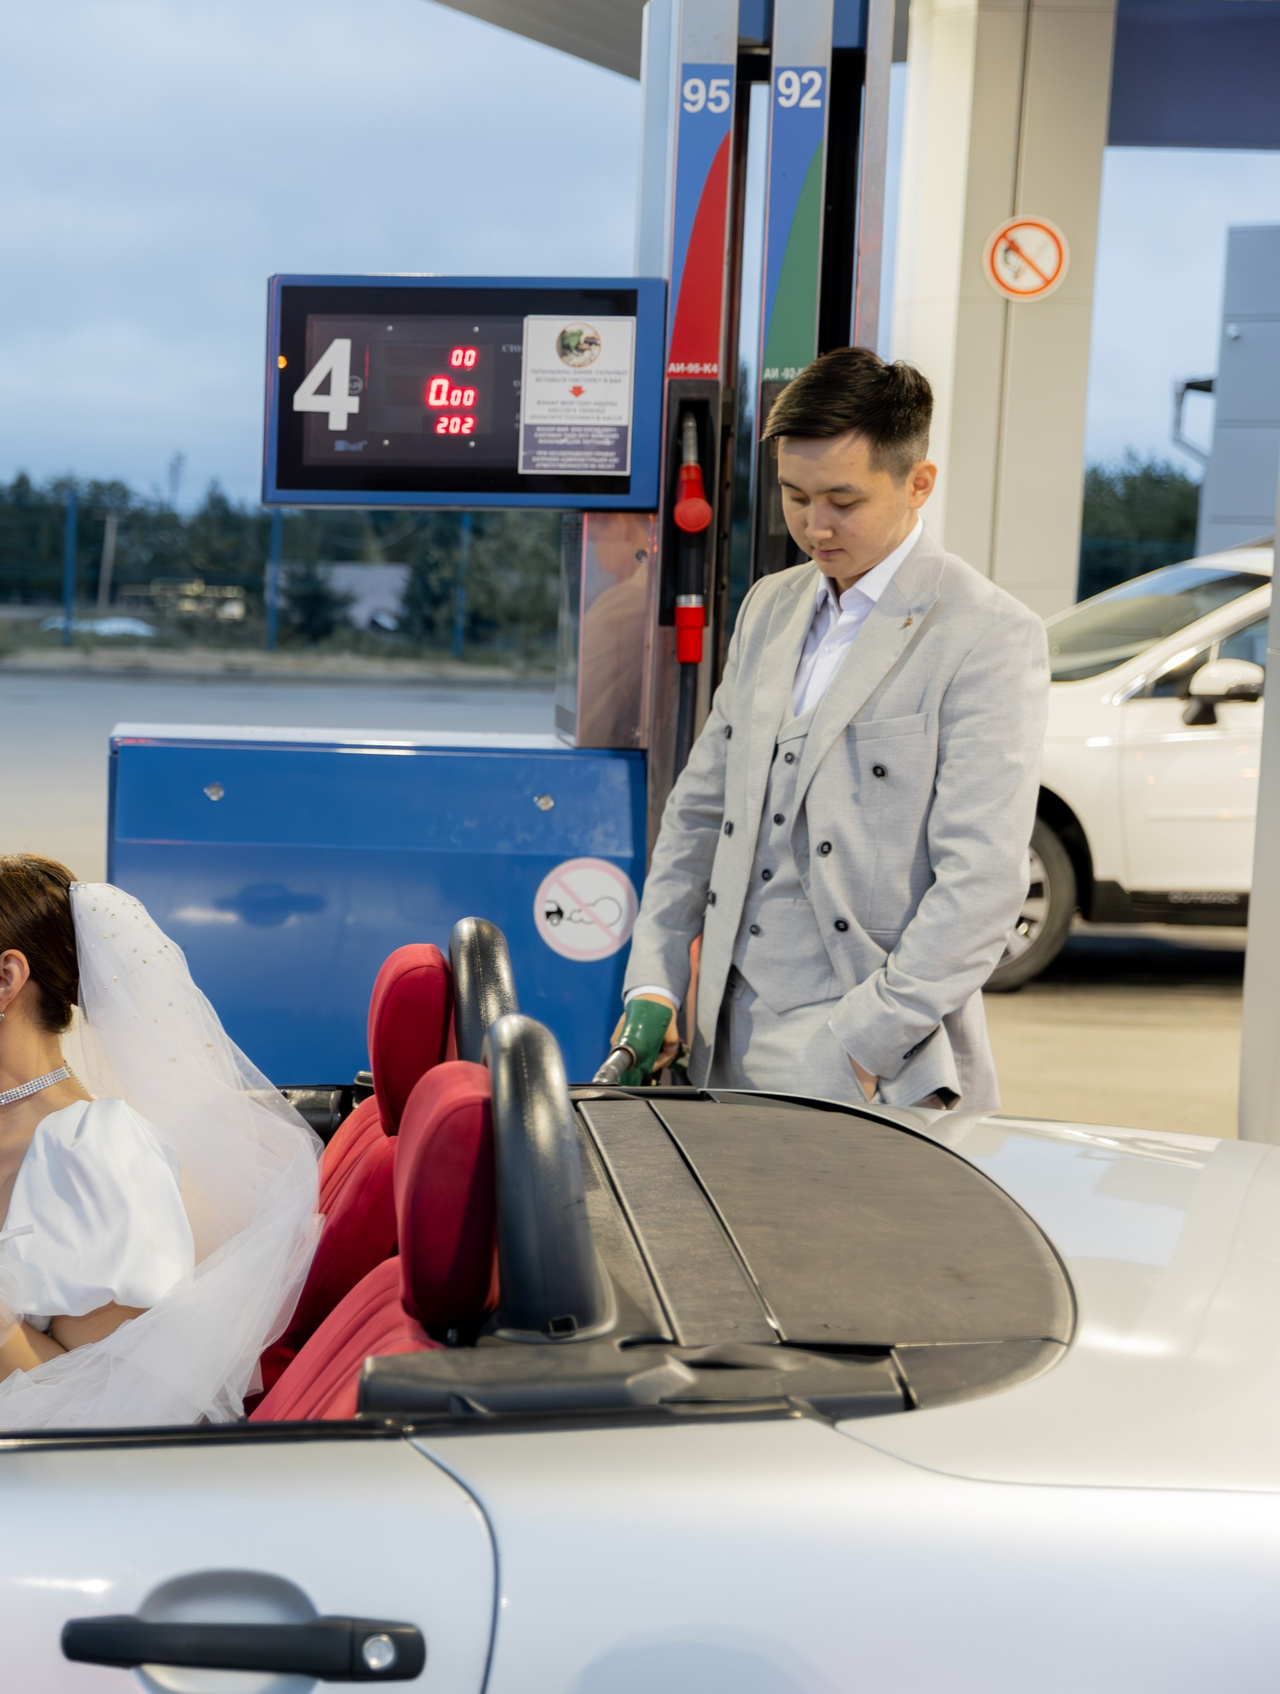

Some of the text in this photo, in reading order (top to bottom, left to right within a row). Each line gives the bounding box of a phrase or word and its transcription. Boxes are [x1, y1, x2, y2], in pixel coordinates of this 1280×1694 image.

[683, 78, 730, 113] 95
[777, 70, 823, 108] 92
[450, 348, 477, 367] 00
[293, 338, 360, 431] 4
[436, 416, 474, 435] 202
